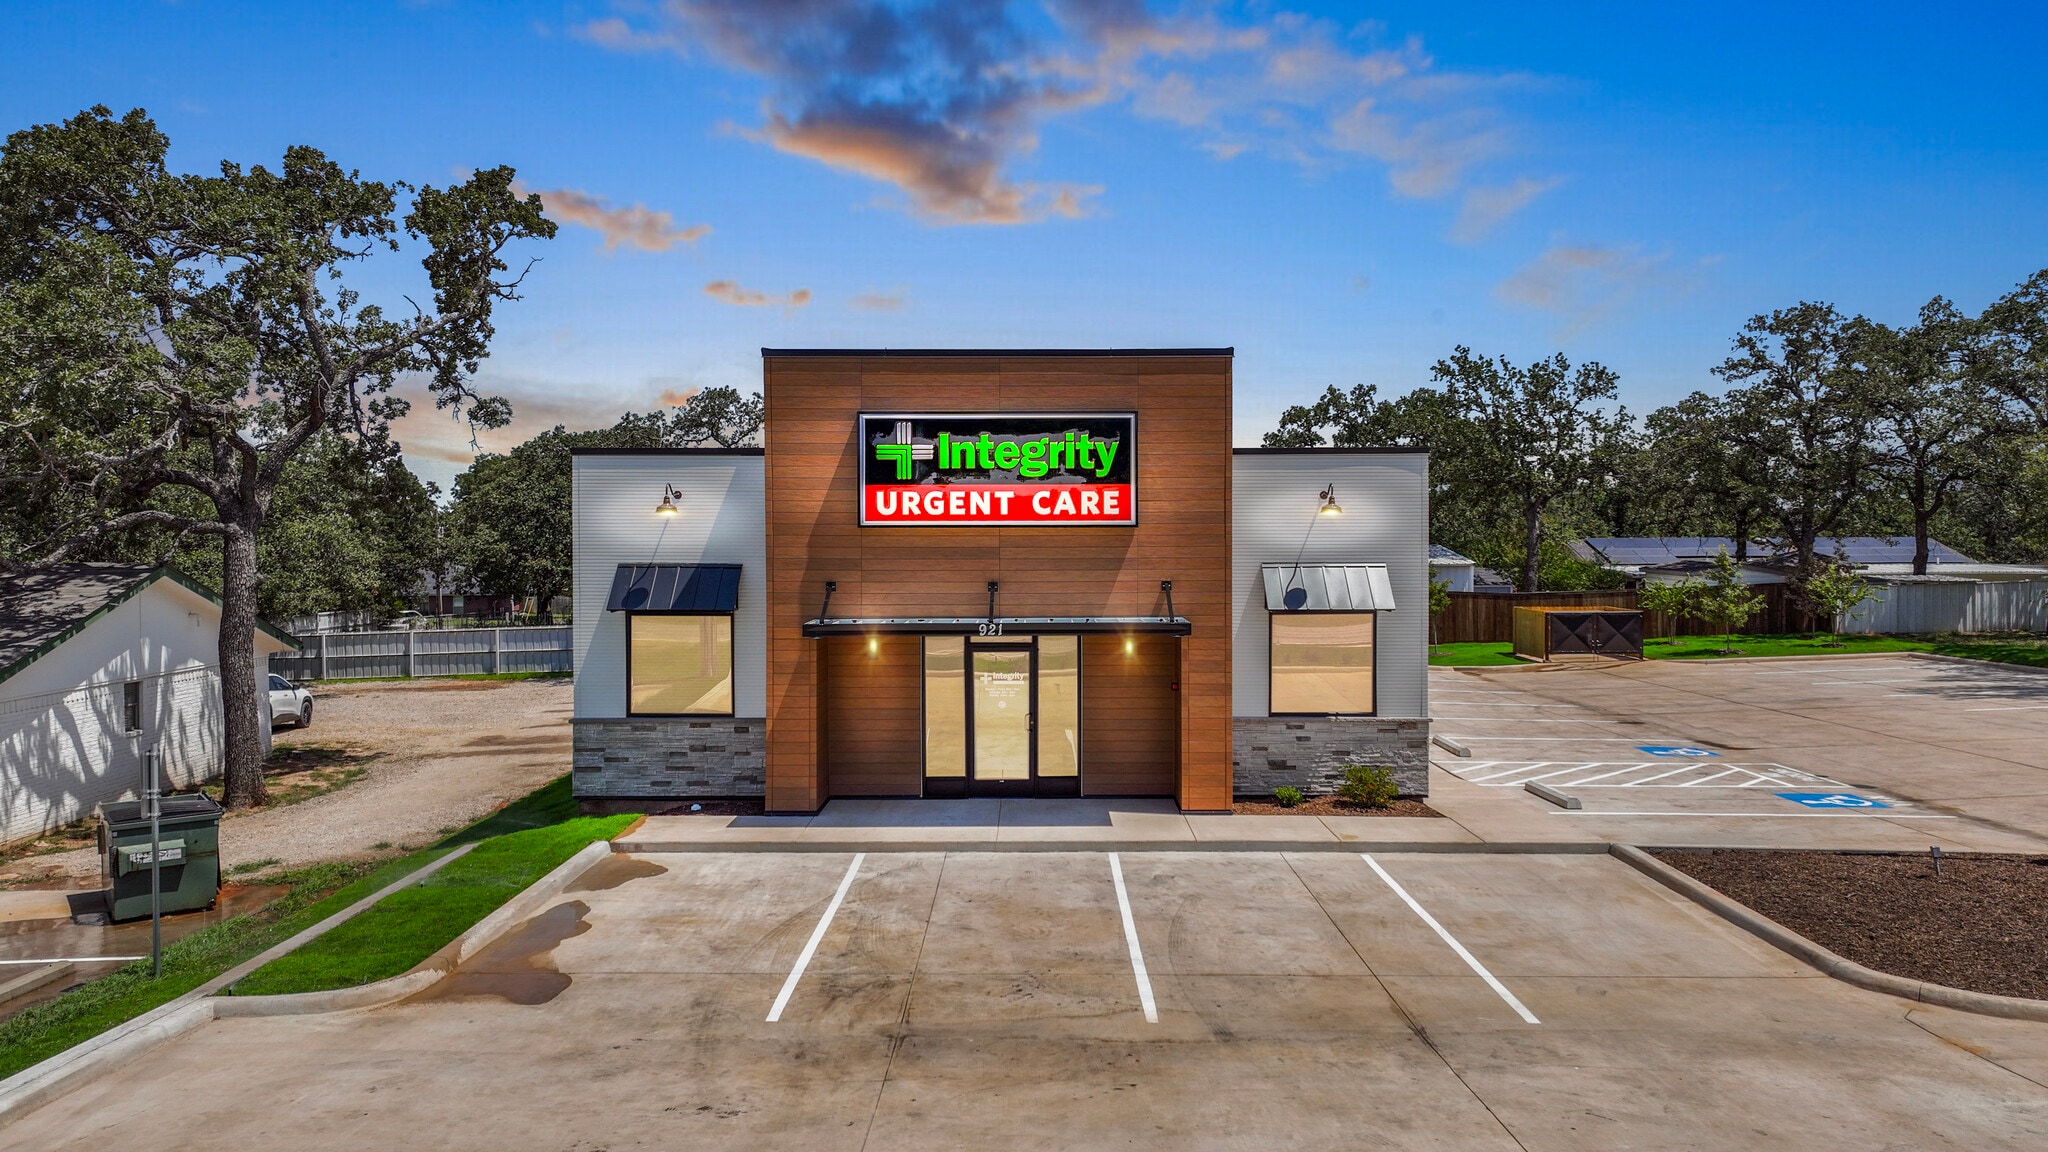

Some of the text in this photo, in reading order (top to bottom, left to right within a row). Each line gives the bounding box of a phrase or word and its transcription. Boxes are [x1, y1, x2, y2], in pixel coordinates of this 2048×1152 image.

[938, 432, 1119, 477] Integrity
[876, 491, 1120, 516] URGENT CARE
[979, 623, 1003, 636] 921
[992, 672, 1024, 680] Integrity
